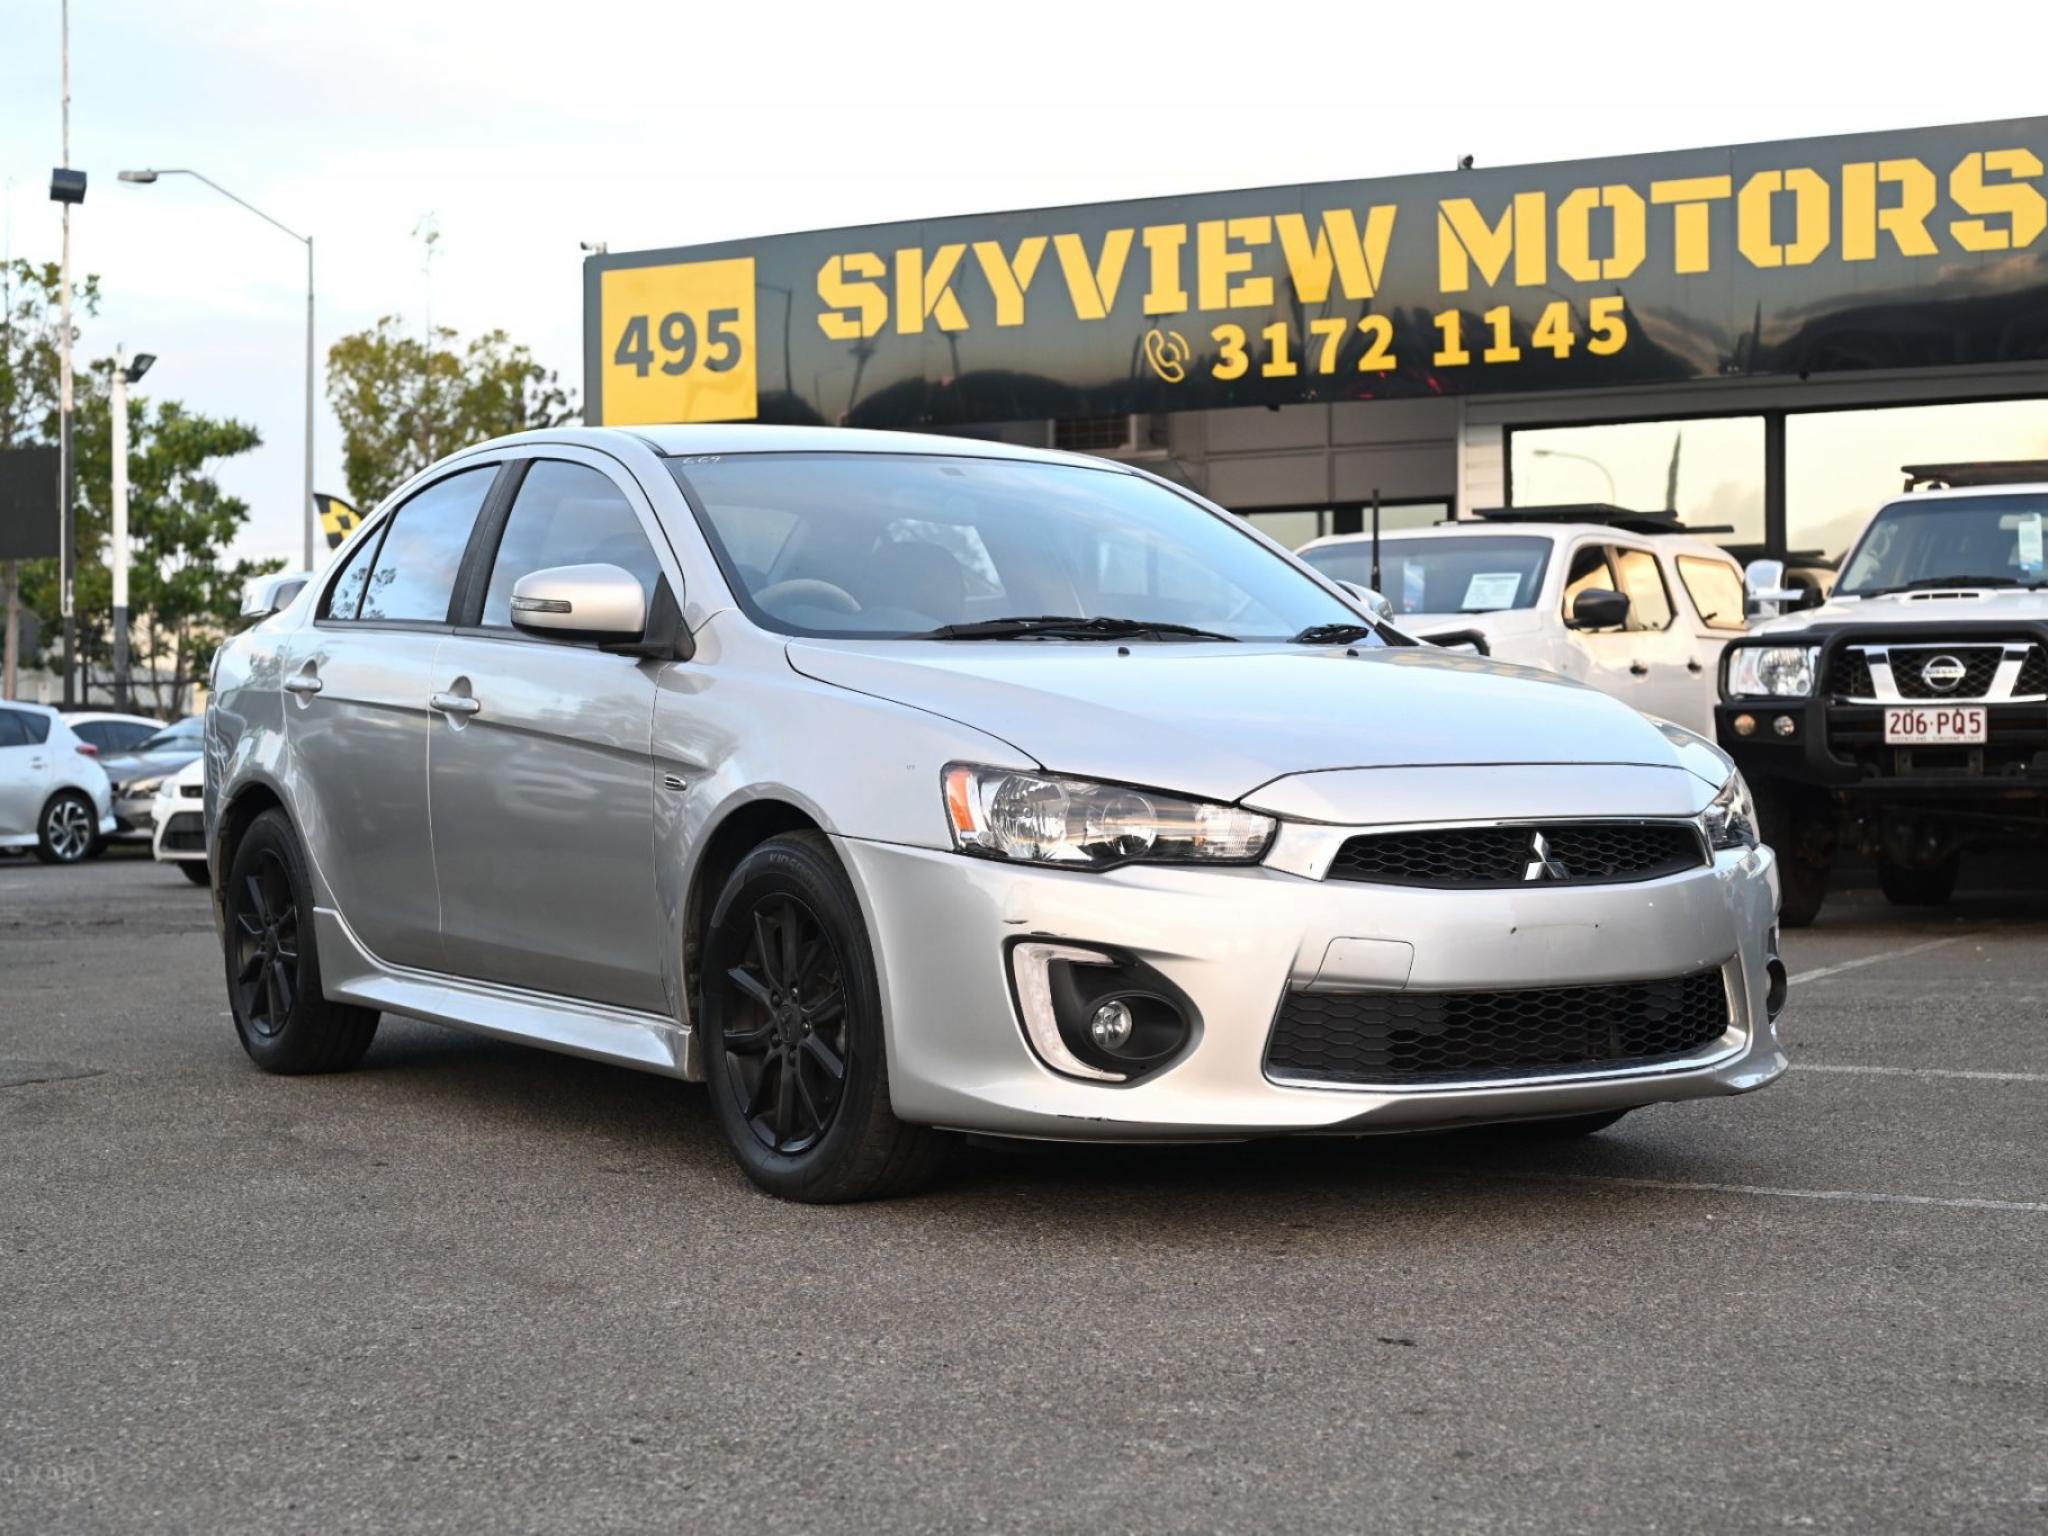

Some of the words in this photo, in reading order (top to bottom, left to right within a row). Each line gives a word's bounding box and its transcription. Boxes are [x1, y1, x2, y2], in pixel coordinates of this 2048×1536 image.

[818, 206, 1398, 339] SKYVIEW
[1438, 149, 2047, 293] MOTORS
[614, 308, 741, 378] 495
[1211, 316, 1397, 380] 3172
[1433, 296, 1628, 366] 1145
